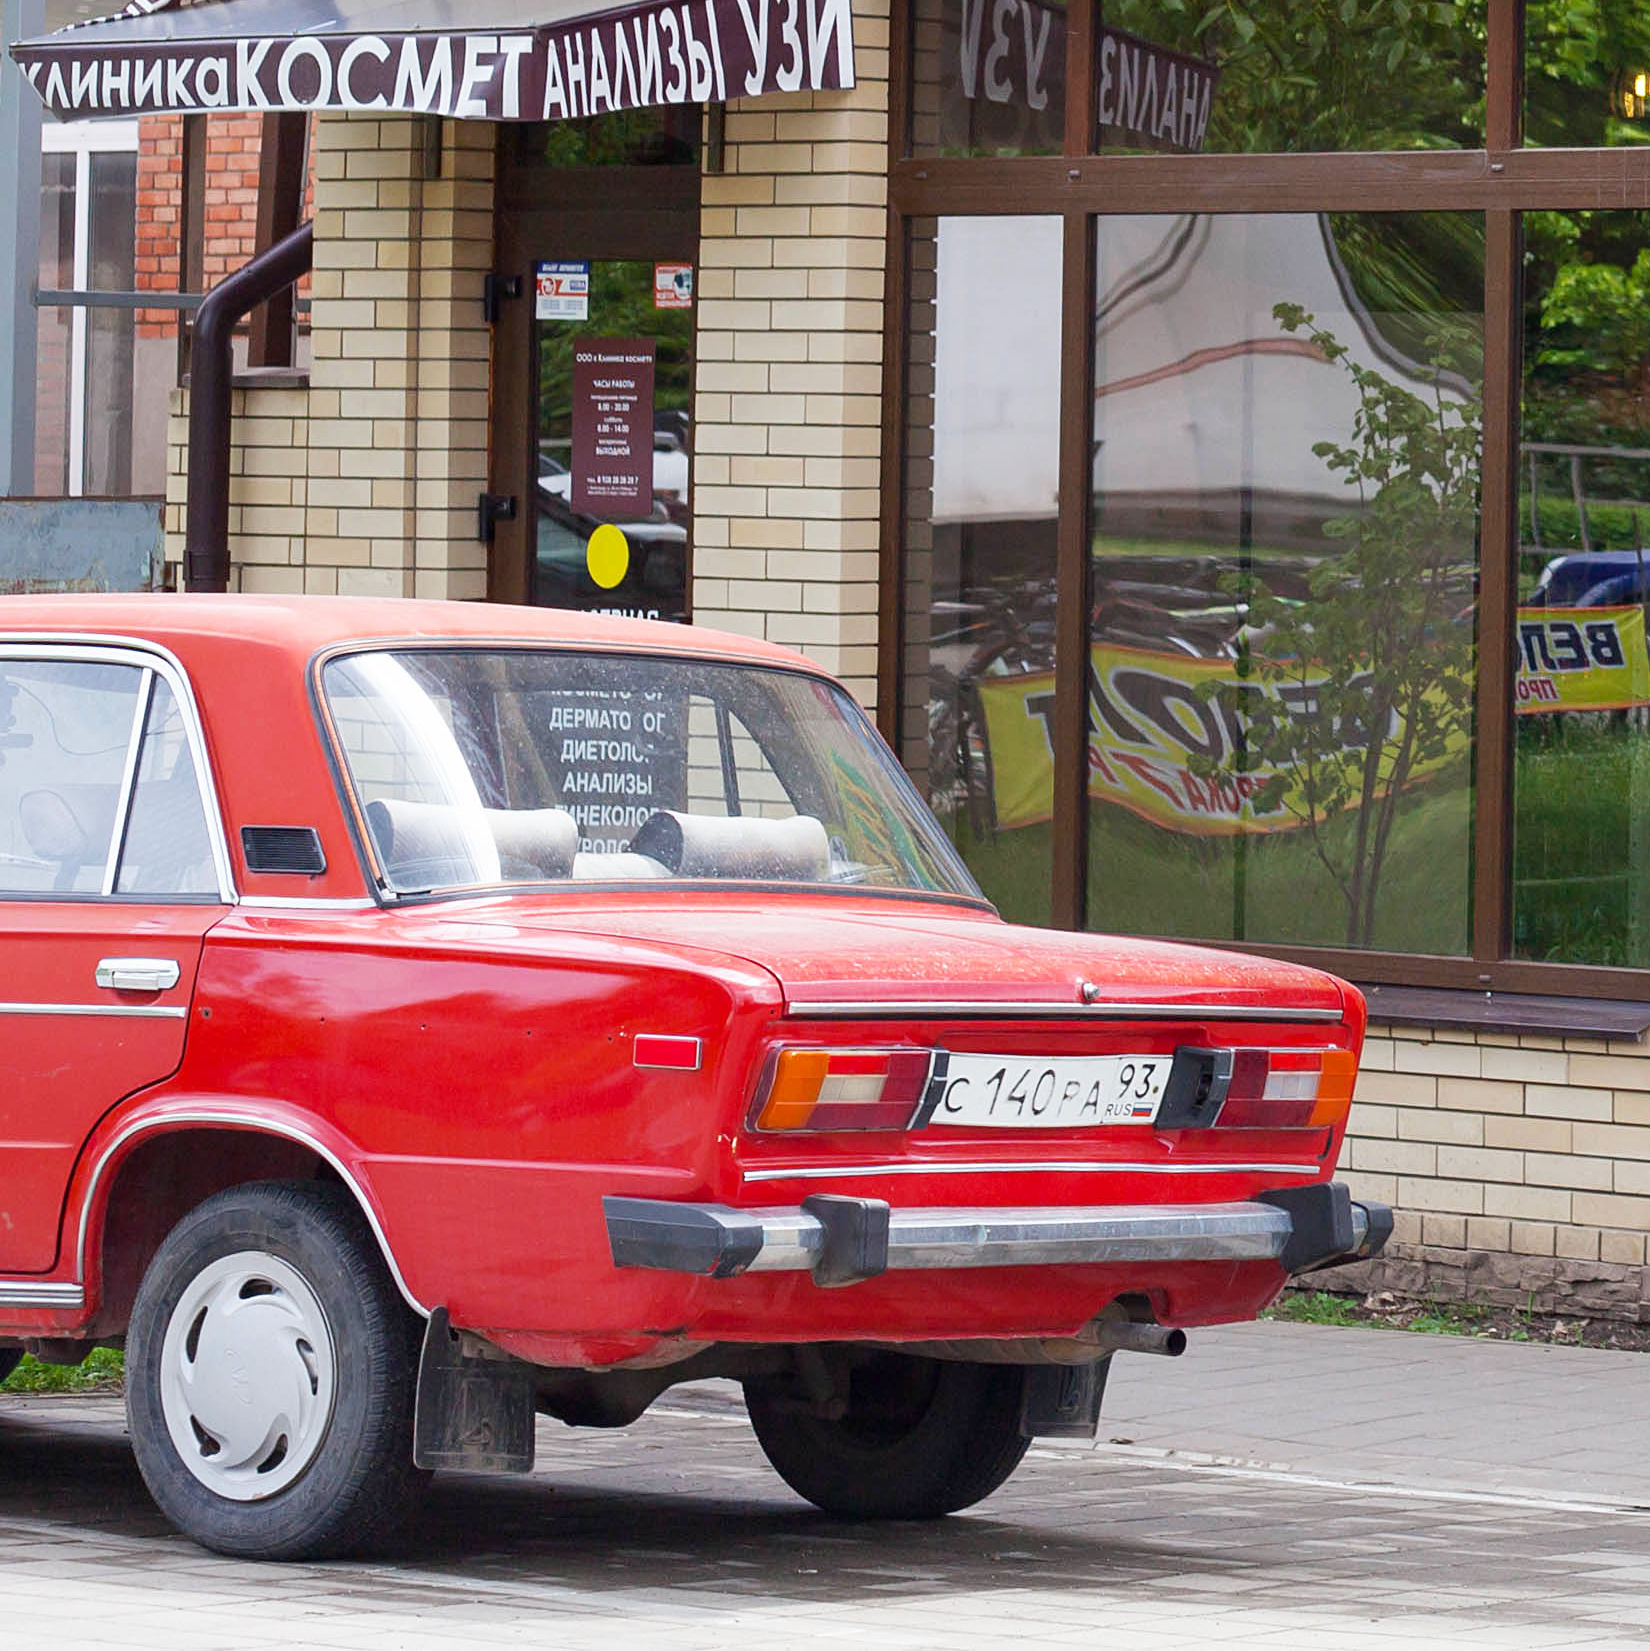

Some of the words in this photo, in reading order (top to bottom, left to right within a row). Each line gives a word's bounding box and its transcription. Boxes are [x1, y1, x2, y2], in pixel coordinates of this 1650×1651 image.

[549, 707, 667, 736] ДЕРМАТООГ
[562, 771, 653, 796] АНАЛИЗЫ
[1118, 1063, 1156, 1099] 93
[1104, 1103, 1133, 1116] RUS
